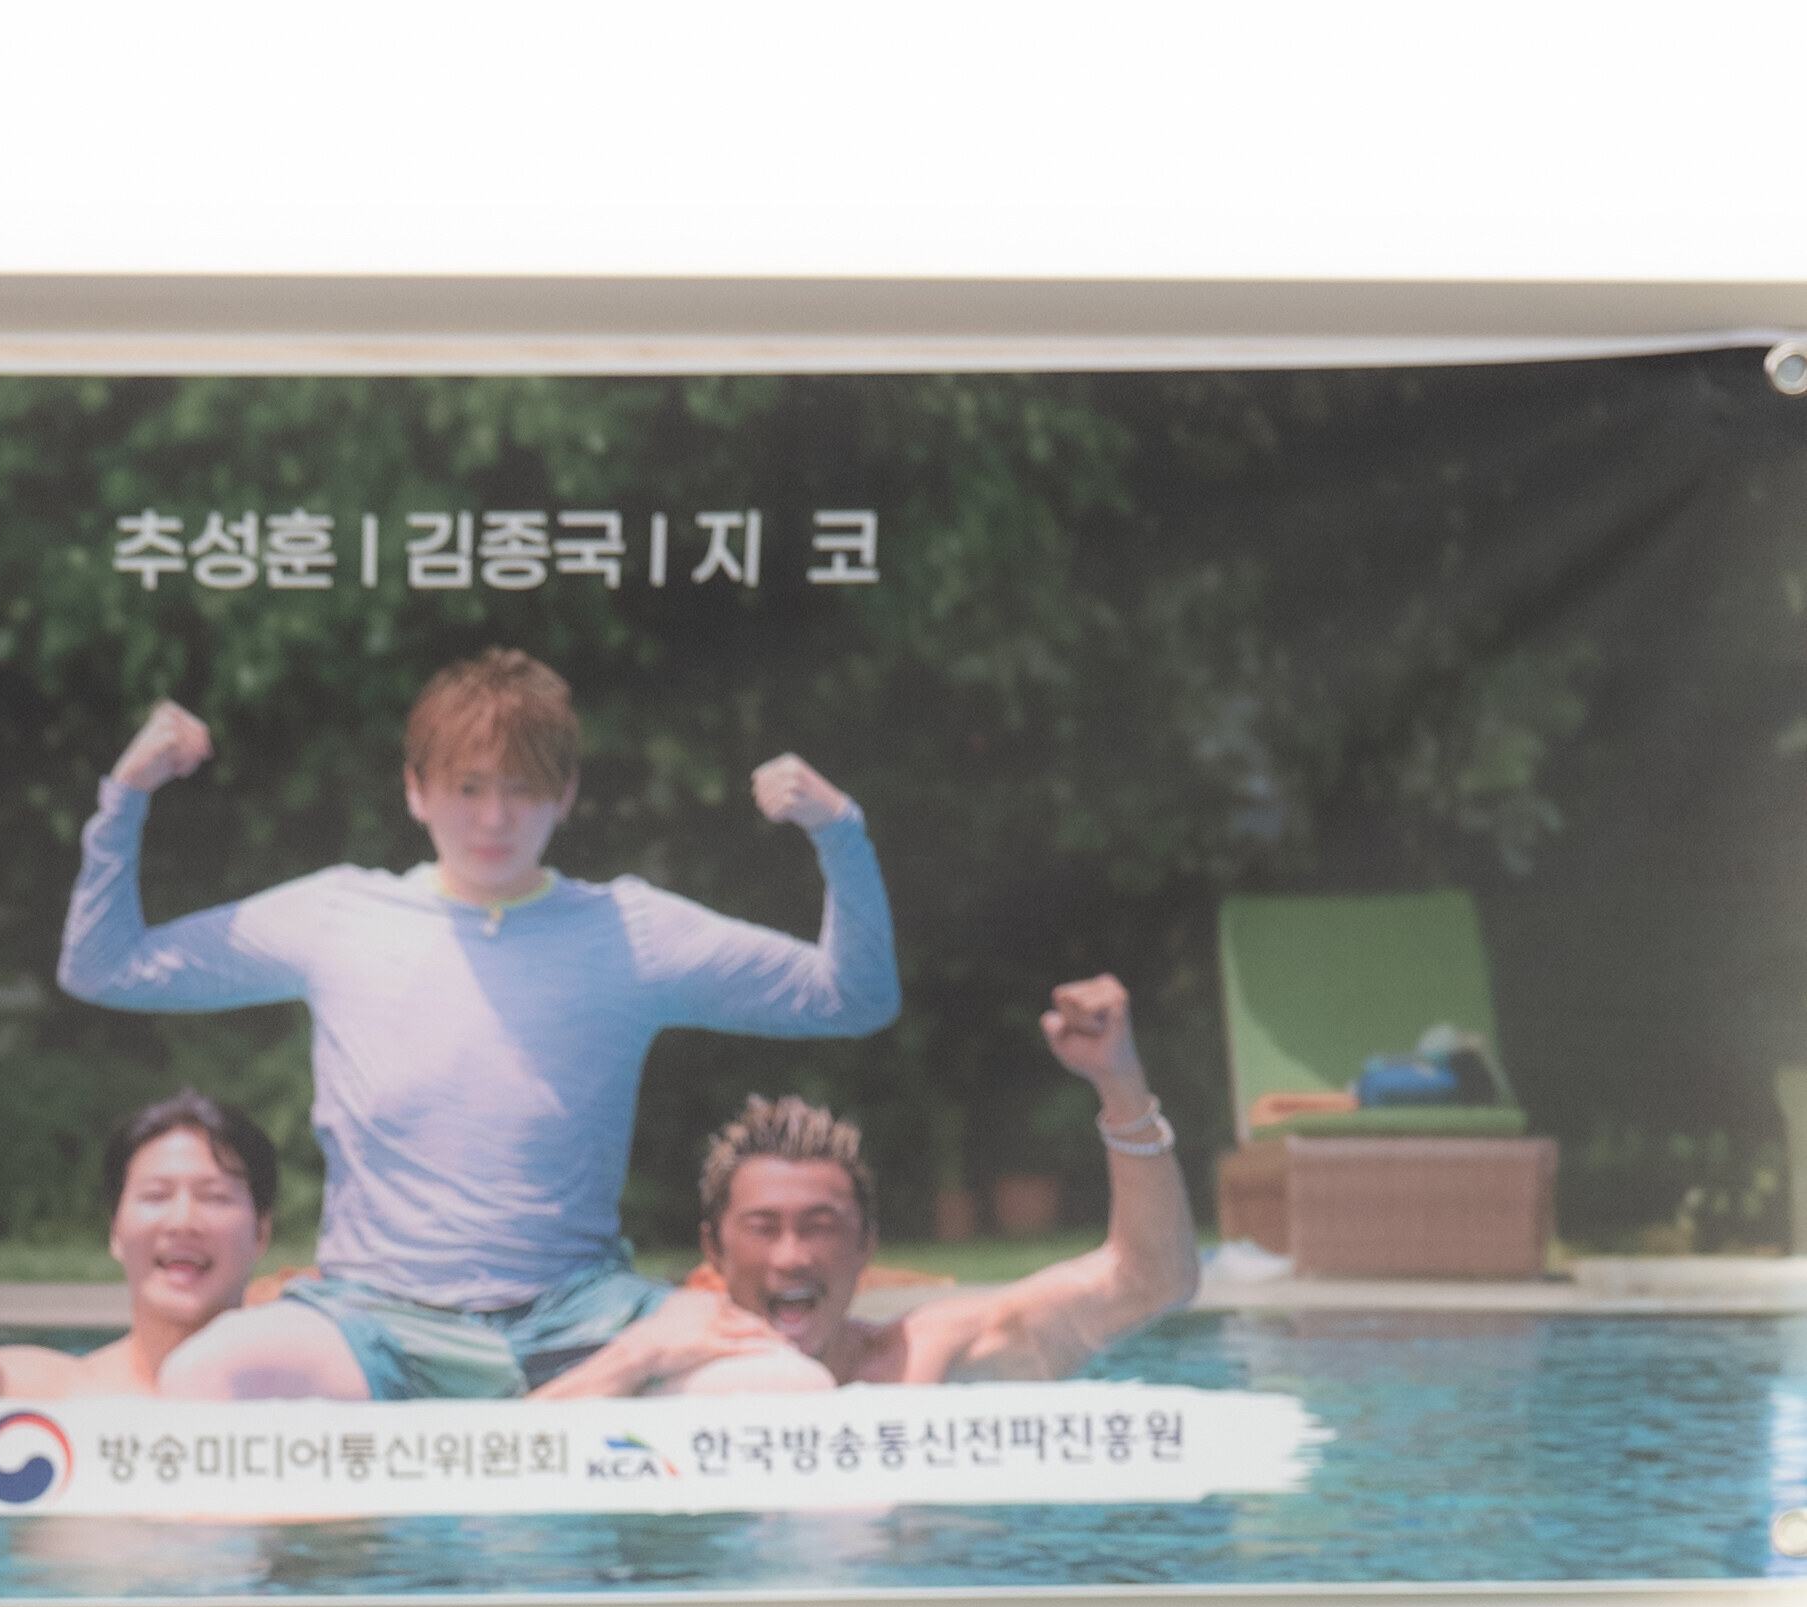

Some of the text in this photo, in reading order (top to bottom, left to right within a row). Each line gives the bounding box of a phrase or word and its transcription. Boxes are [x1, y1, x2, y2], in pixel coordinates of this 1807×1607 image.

[112, 508, 337, 591] 추성훈
[404, 509, 626, 591] 김종국
[97, 1430, 570, 1483] 방송미디어통신위원회
[586, 1458, 659, 1482] KCA
[692, 1409, 1185, 1477] 한국방송통신전파진흥원
